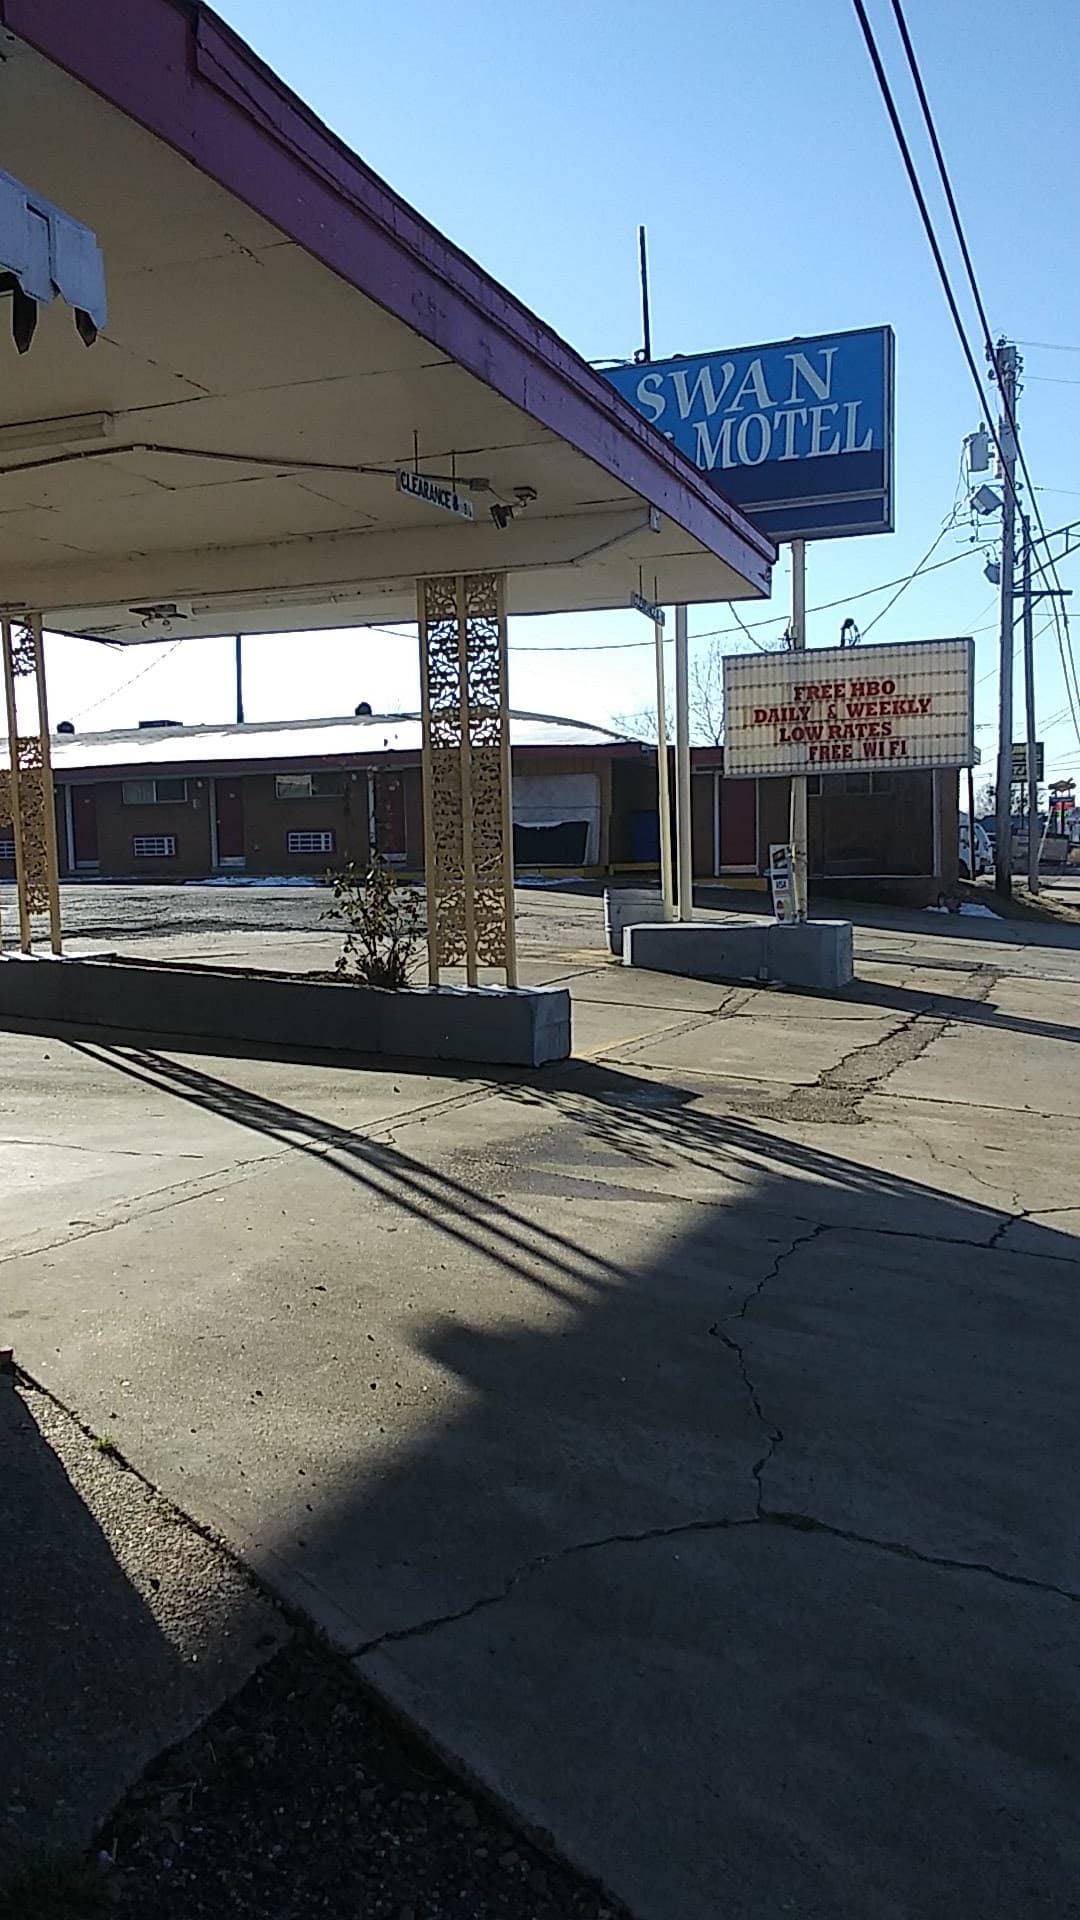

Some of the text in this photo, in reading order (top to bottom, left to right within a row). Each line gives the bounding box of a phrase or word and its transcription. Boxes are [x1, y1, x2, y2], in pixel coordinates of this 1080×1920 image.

[636, 347, 839, 423] SWAN
[693, 400, 873, 471] MOTEL
[400, 471, 451, 510] CLEARANCE
[793, 680, 896, 701] FREE HBO
[753, 698, 932, 724] DAILY & WEEKLY
[779, 721, 892, 743] LOW RATES
[808, 743, 853, 761] FREE
